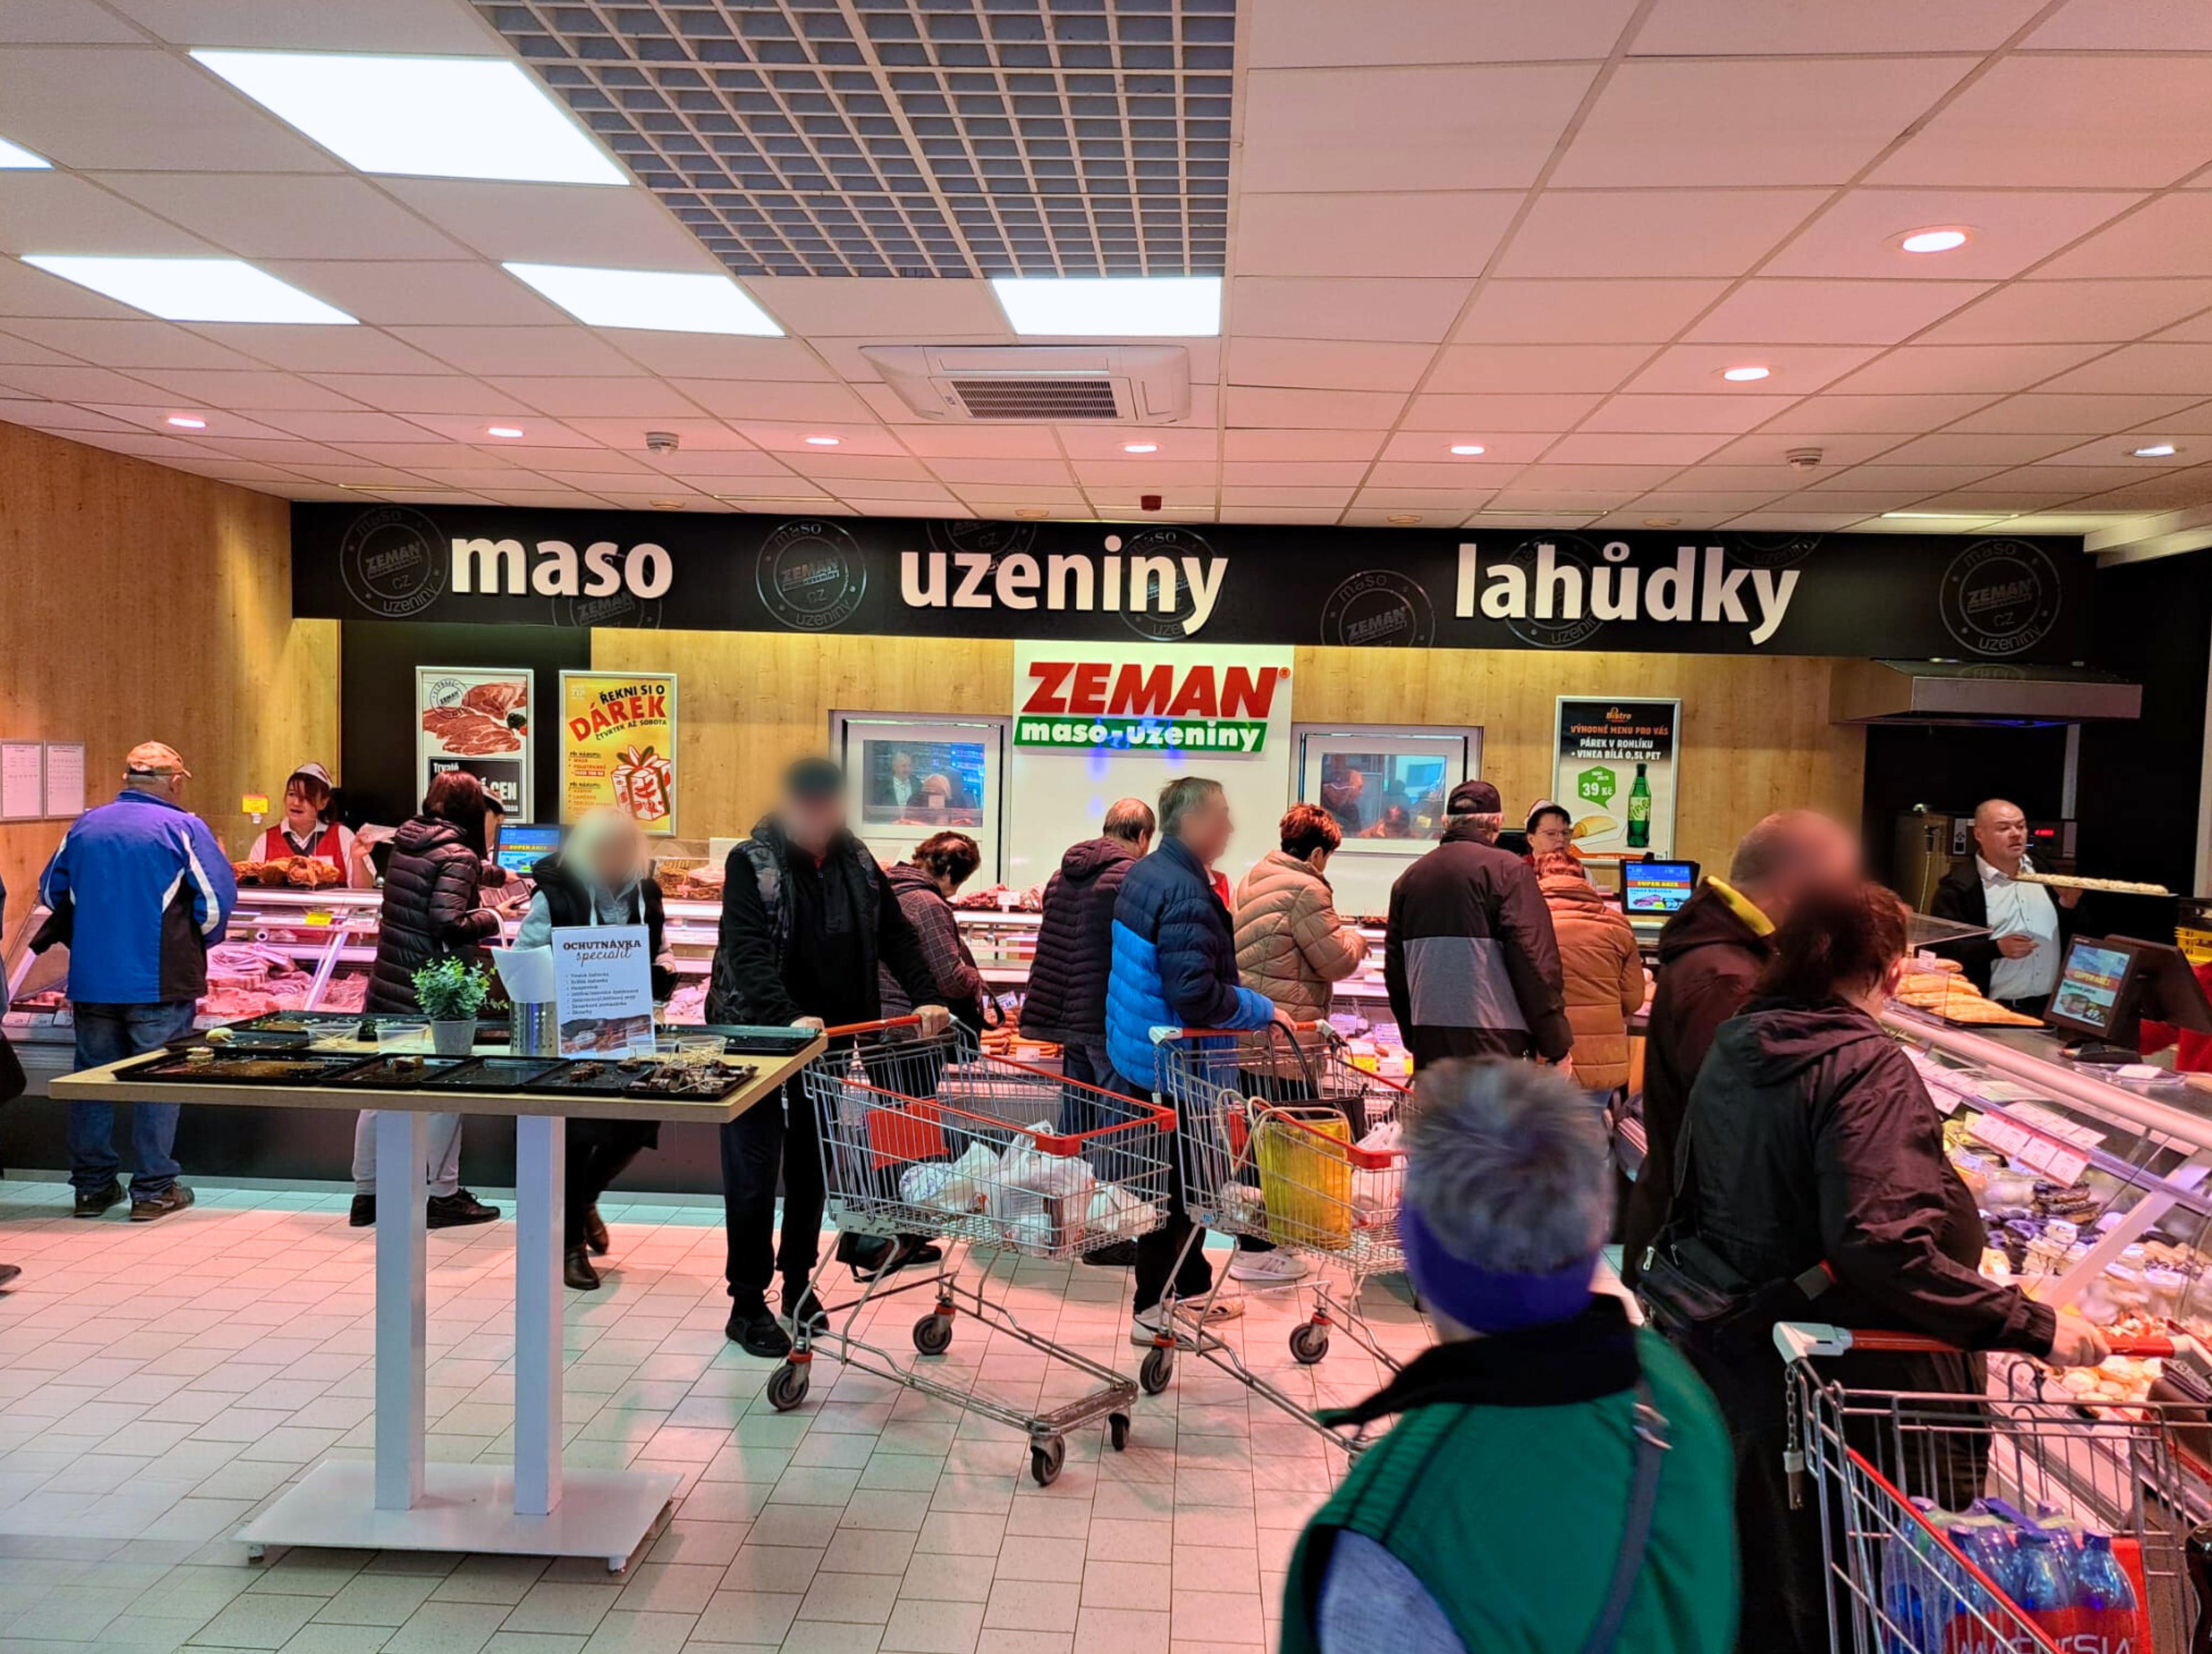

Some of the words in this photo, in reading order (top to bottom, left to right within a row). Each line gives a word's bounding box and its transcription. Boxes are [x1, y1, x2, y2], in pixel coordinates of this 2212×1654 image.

[775, 524, 822, 547] maso
[366, 541, 421, 568] ZEMAN
[1964, 542, 2017, 566] maso
[452, 538, 673, 599] maso
[781, 558, 839, 582] ZEMAN
[383, 583, 438, 613] uzeniny
[901, 535, 1229, 636] uzeniny
[1338, 576, 1387, 602] maso
[1455, 541, 1801, 645] lahůdky
[1967, 580, 2033, 605] ZEMAN
[796, 599, 851, 627] uzeniny
[1347, 608, 1406, 637] ZEMAN
[1551, 614, 1598, 644] uzenin
[1979, 625, 2042, 651] uzeniny
[599, 686, 638, 705] ŘEKNI
[641, 685, 652, 695] SI
[656, 685, 665, 695] O
[1021, 662, 1278, 718] ZEMAN
[569, 696, 666, 742] DÁREK
[1571, 723, 1608, 734] VÝHODNÉ
[1610, 726, 1633, 734] MENU
[1635, 727, 1651, 735] PRO
[1653, 725, 1669, 735] VÁS
[596, 724, 625, 740] ČTVRTEK
[1021, 721, 1261, 753] maso-uzeniny
[1580, 736, 1607, 747] PÁREK
[1609, 739, 1615, 748] V
[1617, 738, 1653, 749] ROHLÍKU
[1604, 748, 1623, 759] BÍLÁ
[1646, 752, 1662, 760] PET
[434, 762, 460, 774] Trvalé
[490, 781, 518, 800] CEN
[1582, 782, 1599, 796] 39
[1601, 786, 1613, 796] Kč
[563, 939, 641, 950] OCHUTNÁVKA
